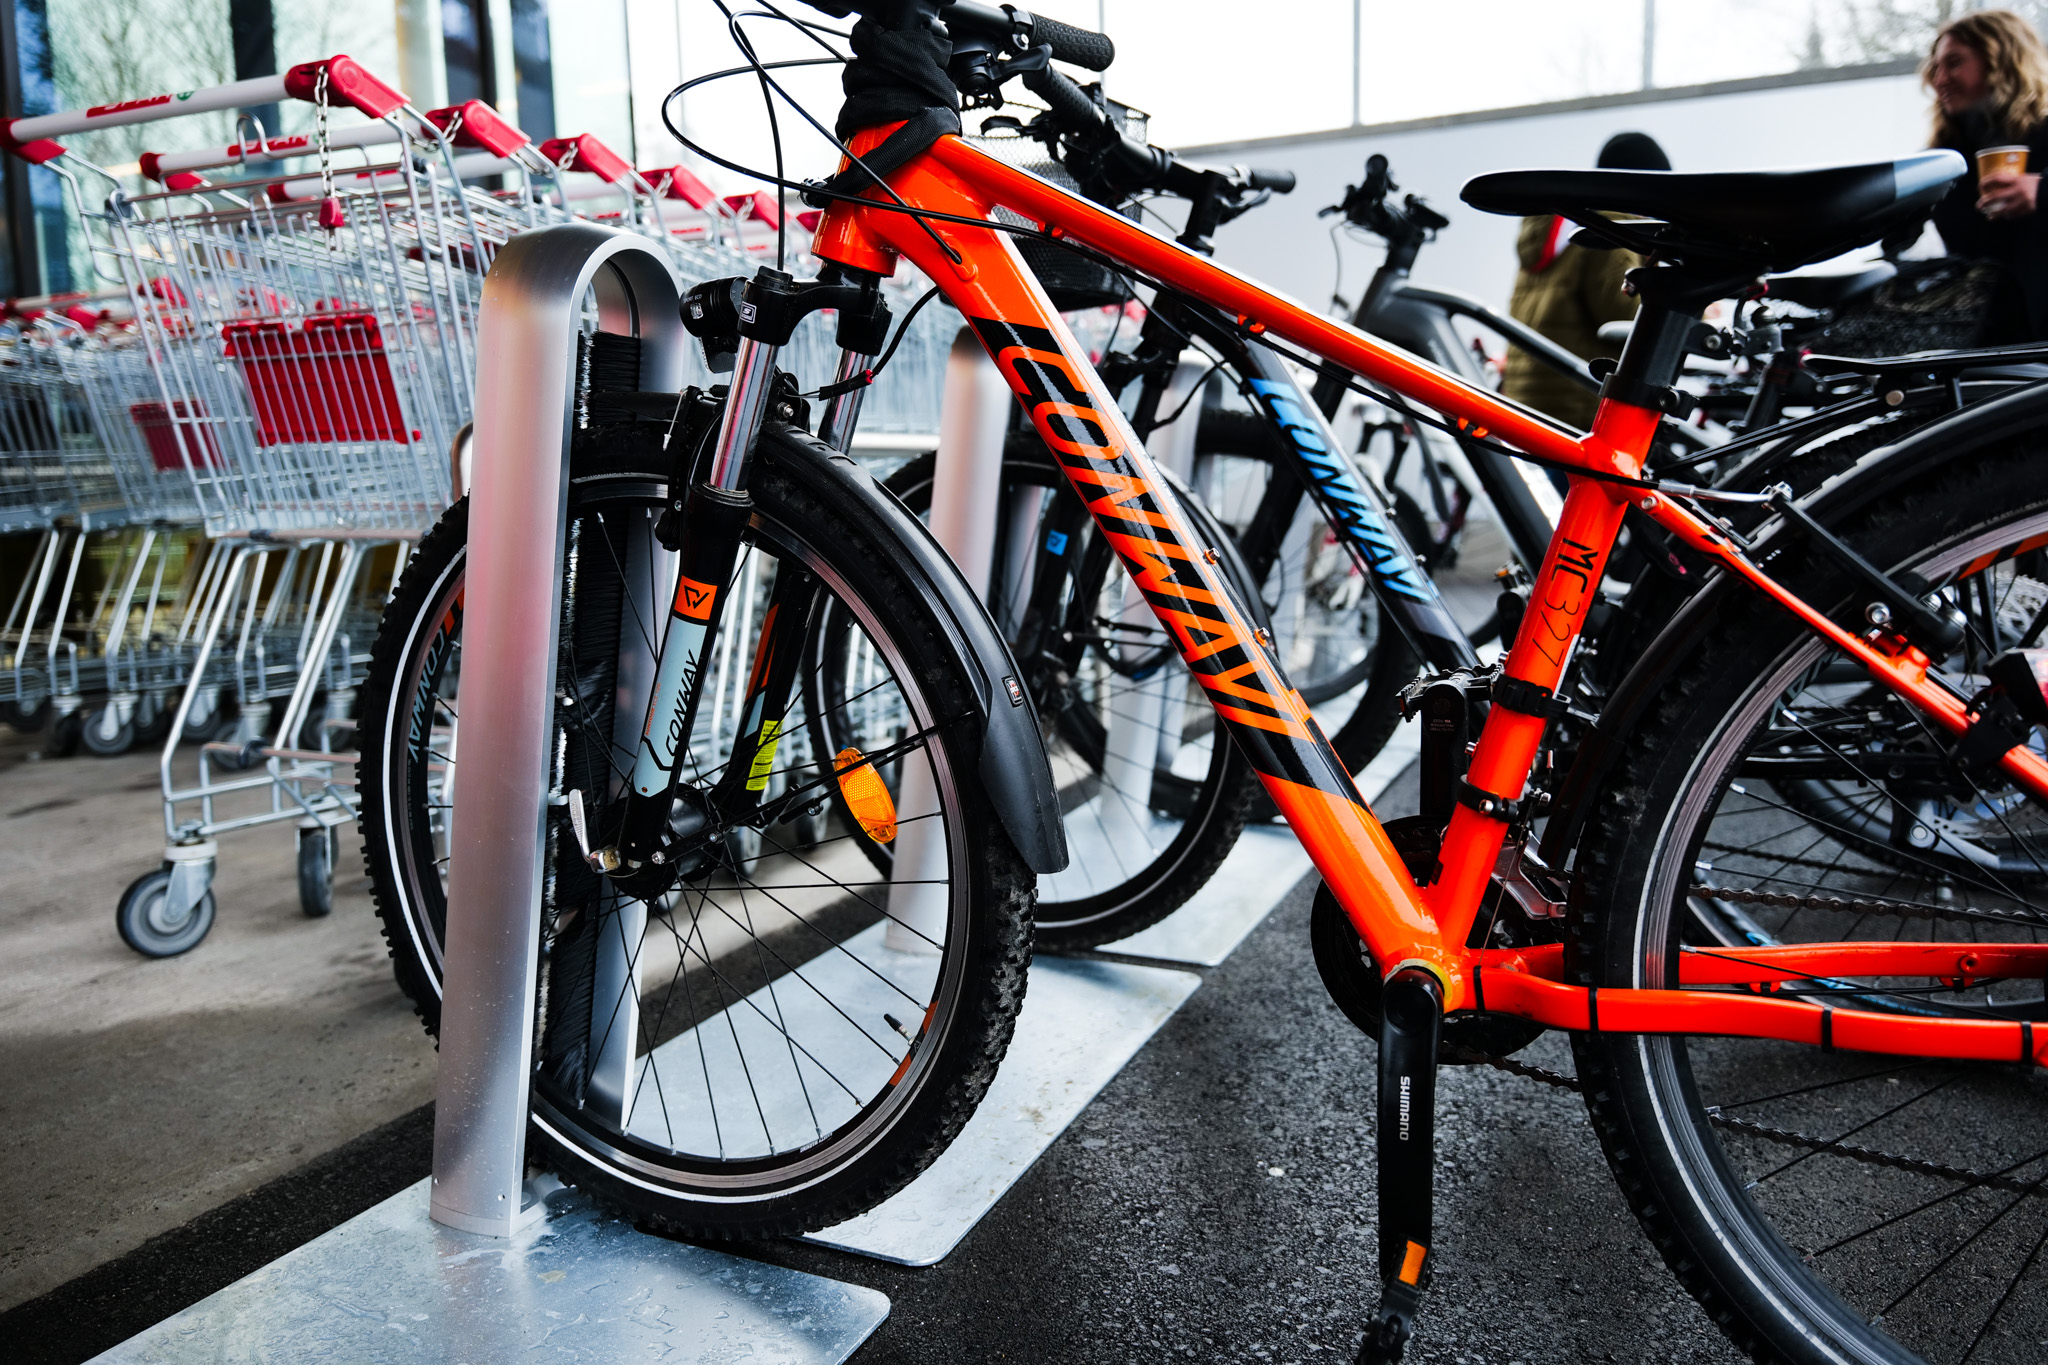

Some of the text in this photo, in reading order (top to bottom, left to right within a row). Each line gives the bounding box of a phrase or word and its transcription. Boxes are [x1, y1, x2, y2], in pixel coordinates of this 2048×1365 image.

[998, 345, 1300, 730] CONWAY
[1258, 388, 1430, 602] CONWAY
[408, 627, 446, 764] CONWAY
[665, 648, 699, 758] CONWAY
[1400, 1075, 1411, 1141] SHIMANO
